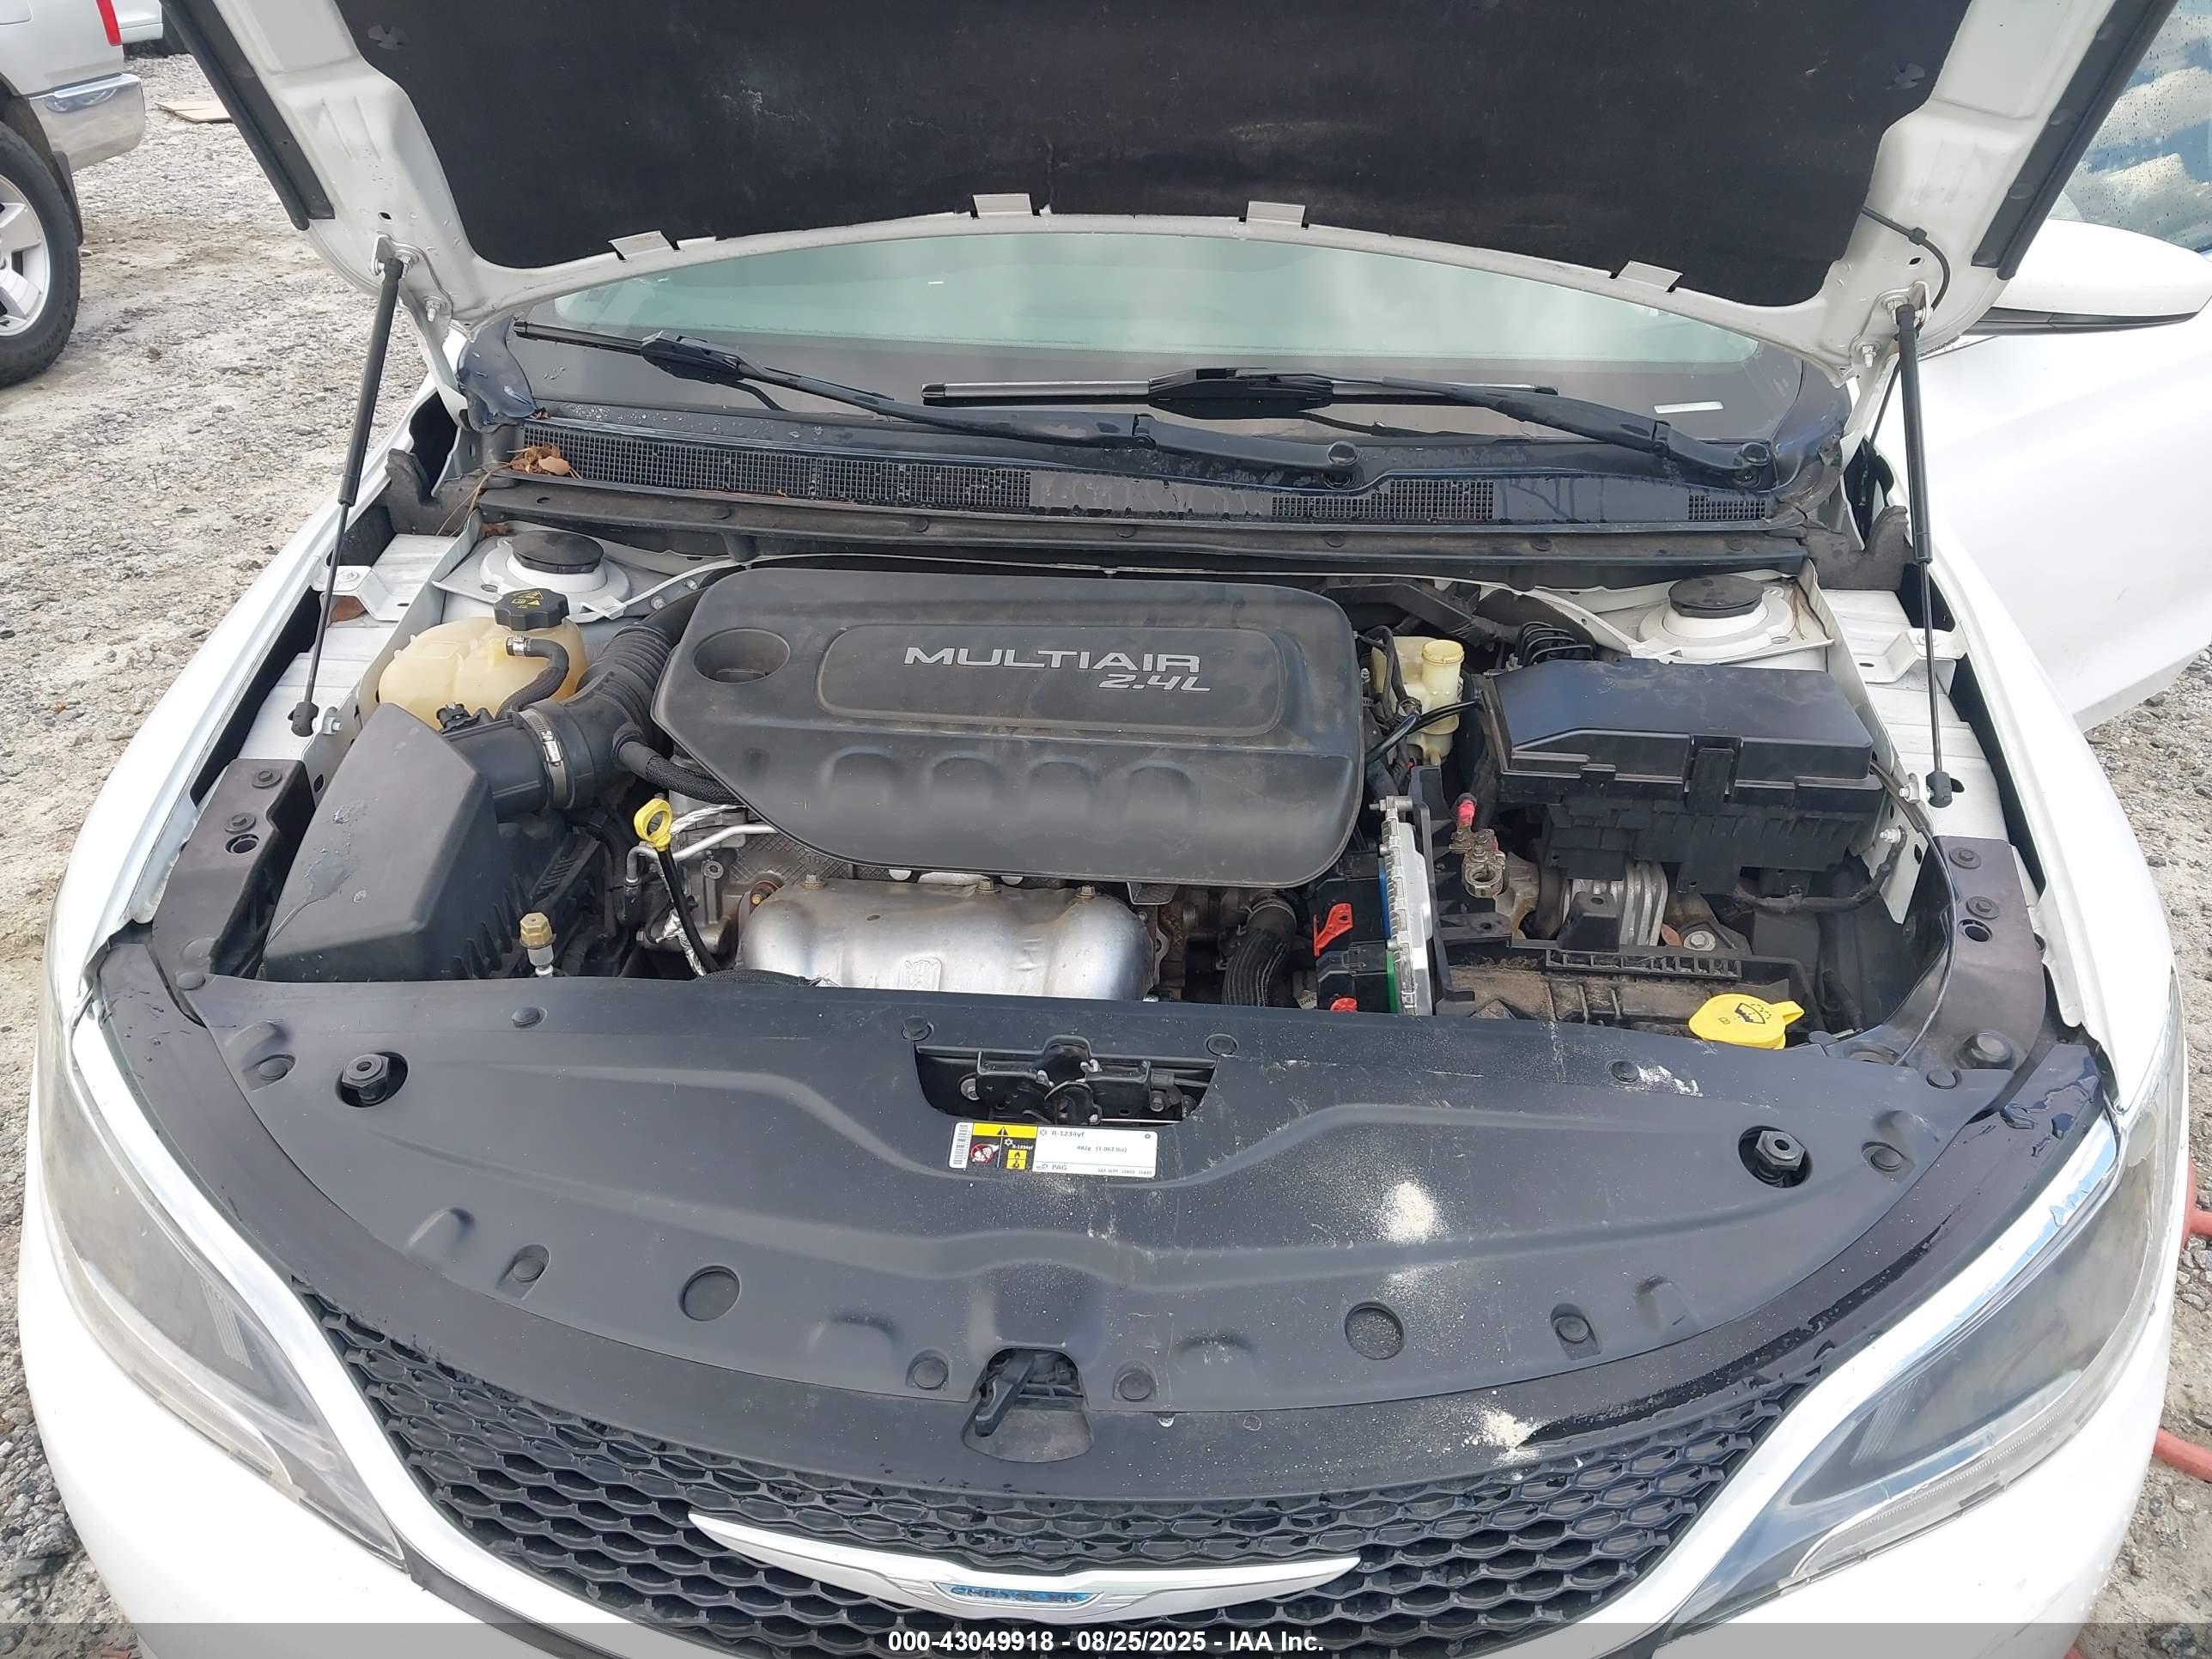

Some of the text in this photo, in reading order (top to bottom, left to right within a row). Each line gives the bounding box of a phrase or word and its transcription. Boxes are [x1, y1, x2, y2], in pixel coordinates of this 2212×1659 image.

[903, 646, 1200, 673] MULTIAIR
[1097, 673, 1212, 692] 2.4L
[1051, 1130, 1085, 1139] R-1234yf
